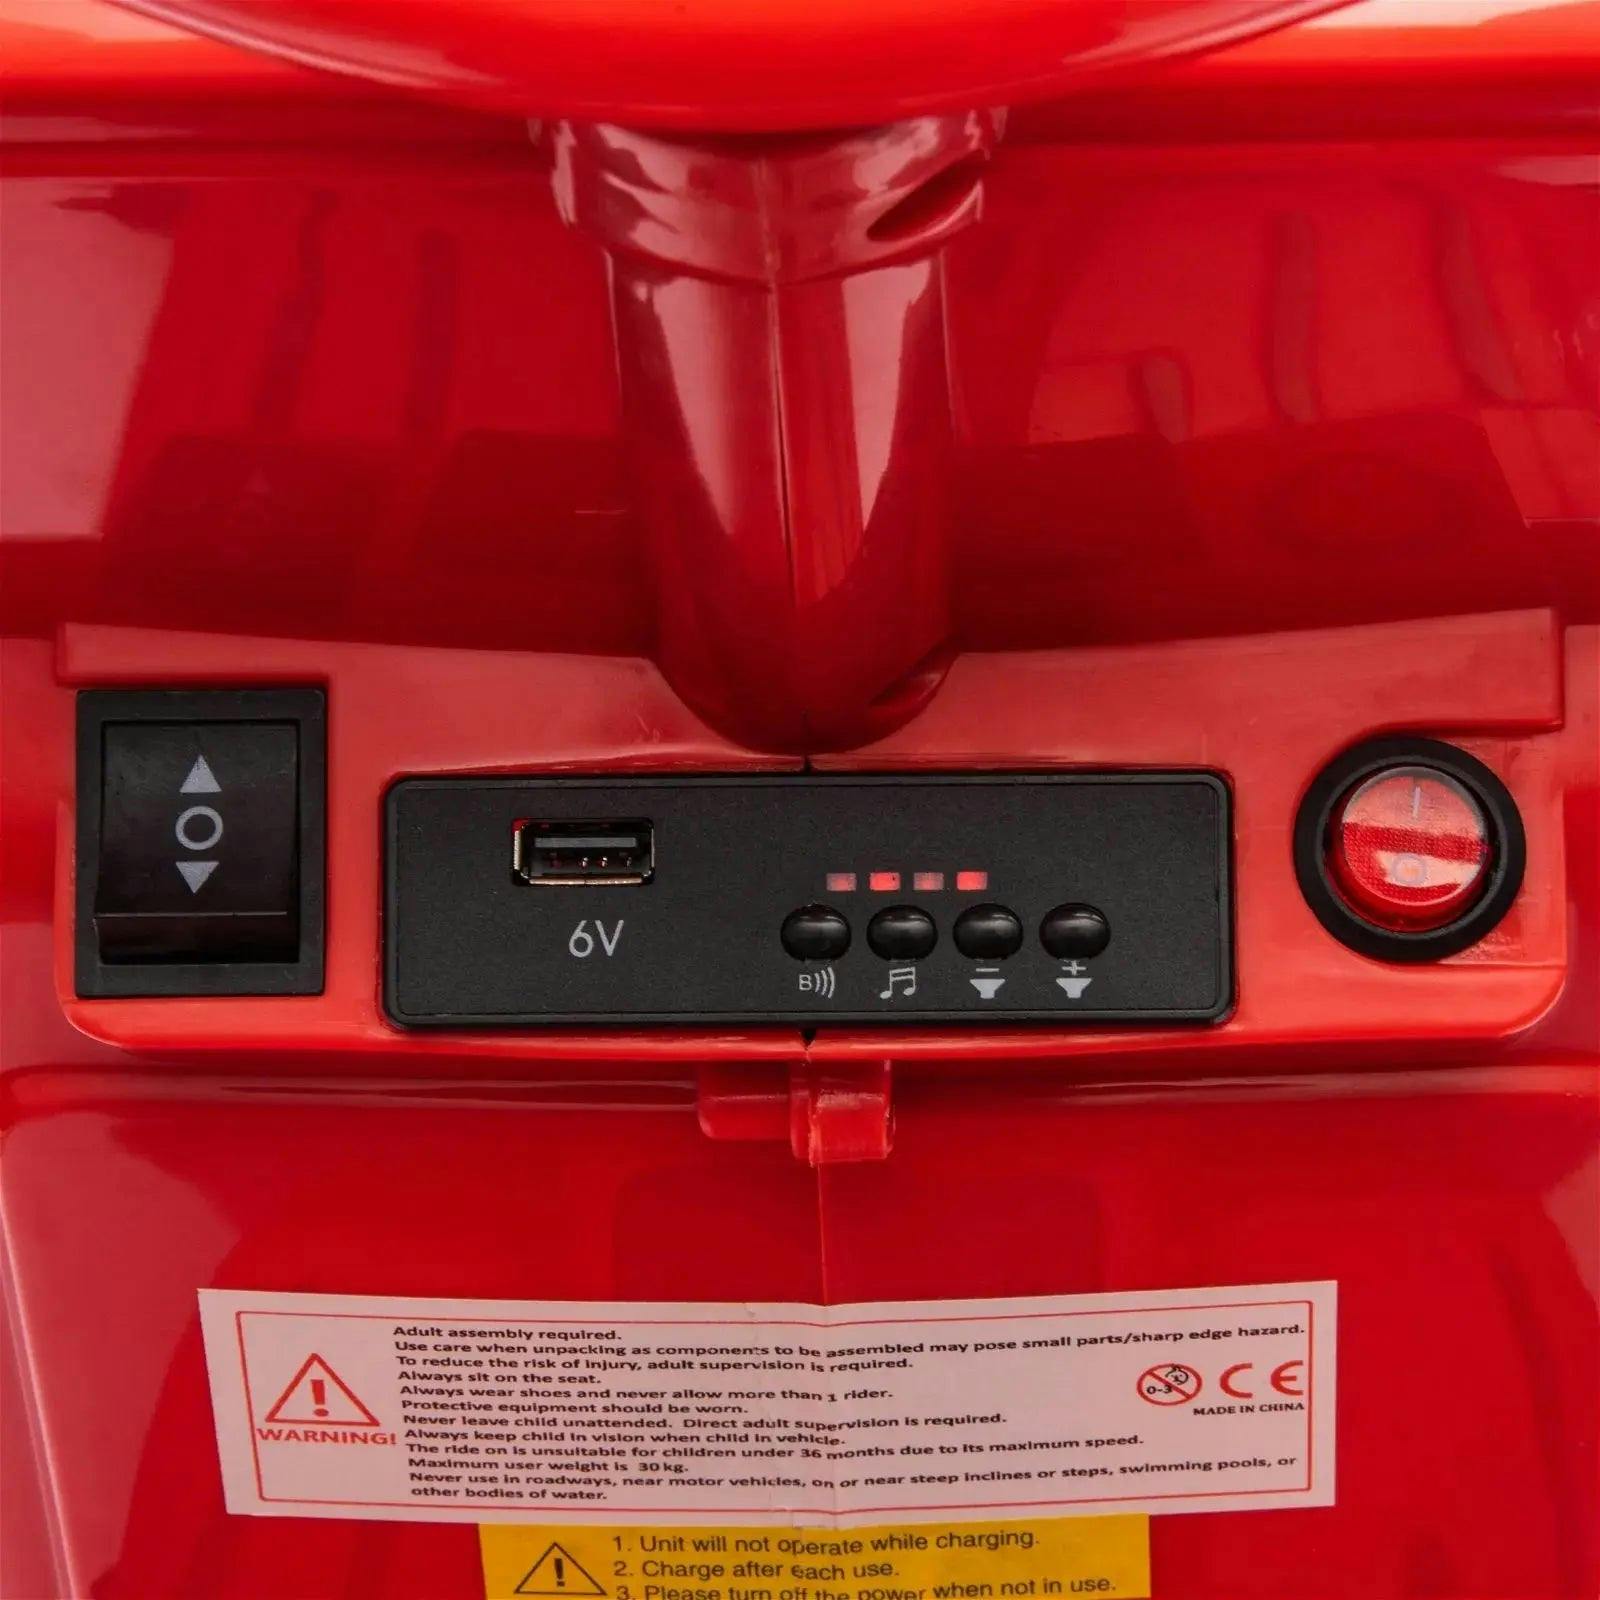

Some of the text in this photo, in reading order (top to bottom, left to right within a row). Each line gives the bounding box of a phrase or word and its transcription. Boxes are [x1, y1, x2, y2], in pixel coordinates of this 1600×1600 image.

[568, 919, 624, 958] 6V
[393, 1326, 622, 1341] Adult assembly required.
[395, 1324, 1304, 1358] Use care when unpacking as components to be assembled may pose small parts/sharp edge hazard.
[396, 1356, 913, 1372] To reduce the risk of injury, adult supervision is required.
[398, 1371, 601, 1383] Always sit on the seat.
[400, 1386, 892, 1402] Always wear shoes and never allow more than 1 rider.
[402, 1400, 748, 1413] Protective equipment should be worn.
[1193, 1402, 1304, 1415] MADE IN CHINA
[404, 1414, 1006, 1431] Never leave child unattended. Direct adult supervision is required.
[256, 1428, 397, 1445] WARNING!
[405, 1429, 845, 1446] Always keep child in vision when child in vehicle.
[406, 1435, 1143, 1460] The ride on is unsuitable for children under 36 months due to its maximum speed.
[408, 1458, 688, 1474] Maximum user weight is 30 kg.
[410, 1456, 1297, 1489] Never use in roadways, near motor vehicles, on or near steep inclines or steps, swimming pools, or
[411, 1487, 607, 1499] other bodies of water.
[613, 1530, 1039, 1556] 1. Unit will not operate while charging.
[613, 1560, 899, 1581] 2. Charge after each use.
[933, 1583, 992, 1599] when
[1001, 1581, 1035, 1596] not
[1043, 1577, 1062, 1594] in
[1070, 1577, 1116, 1594] use.
